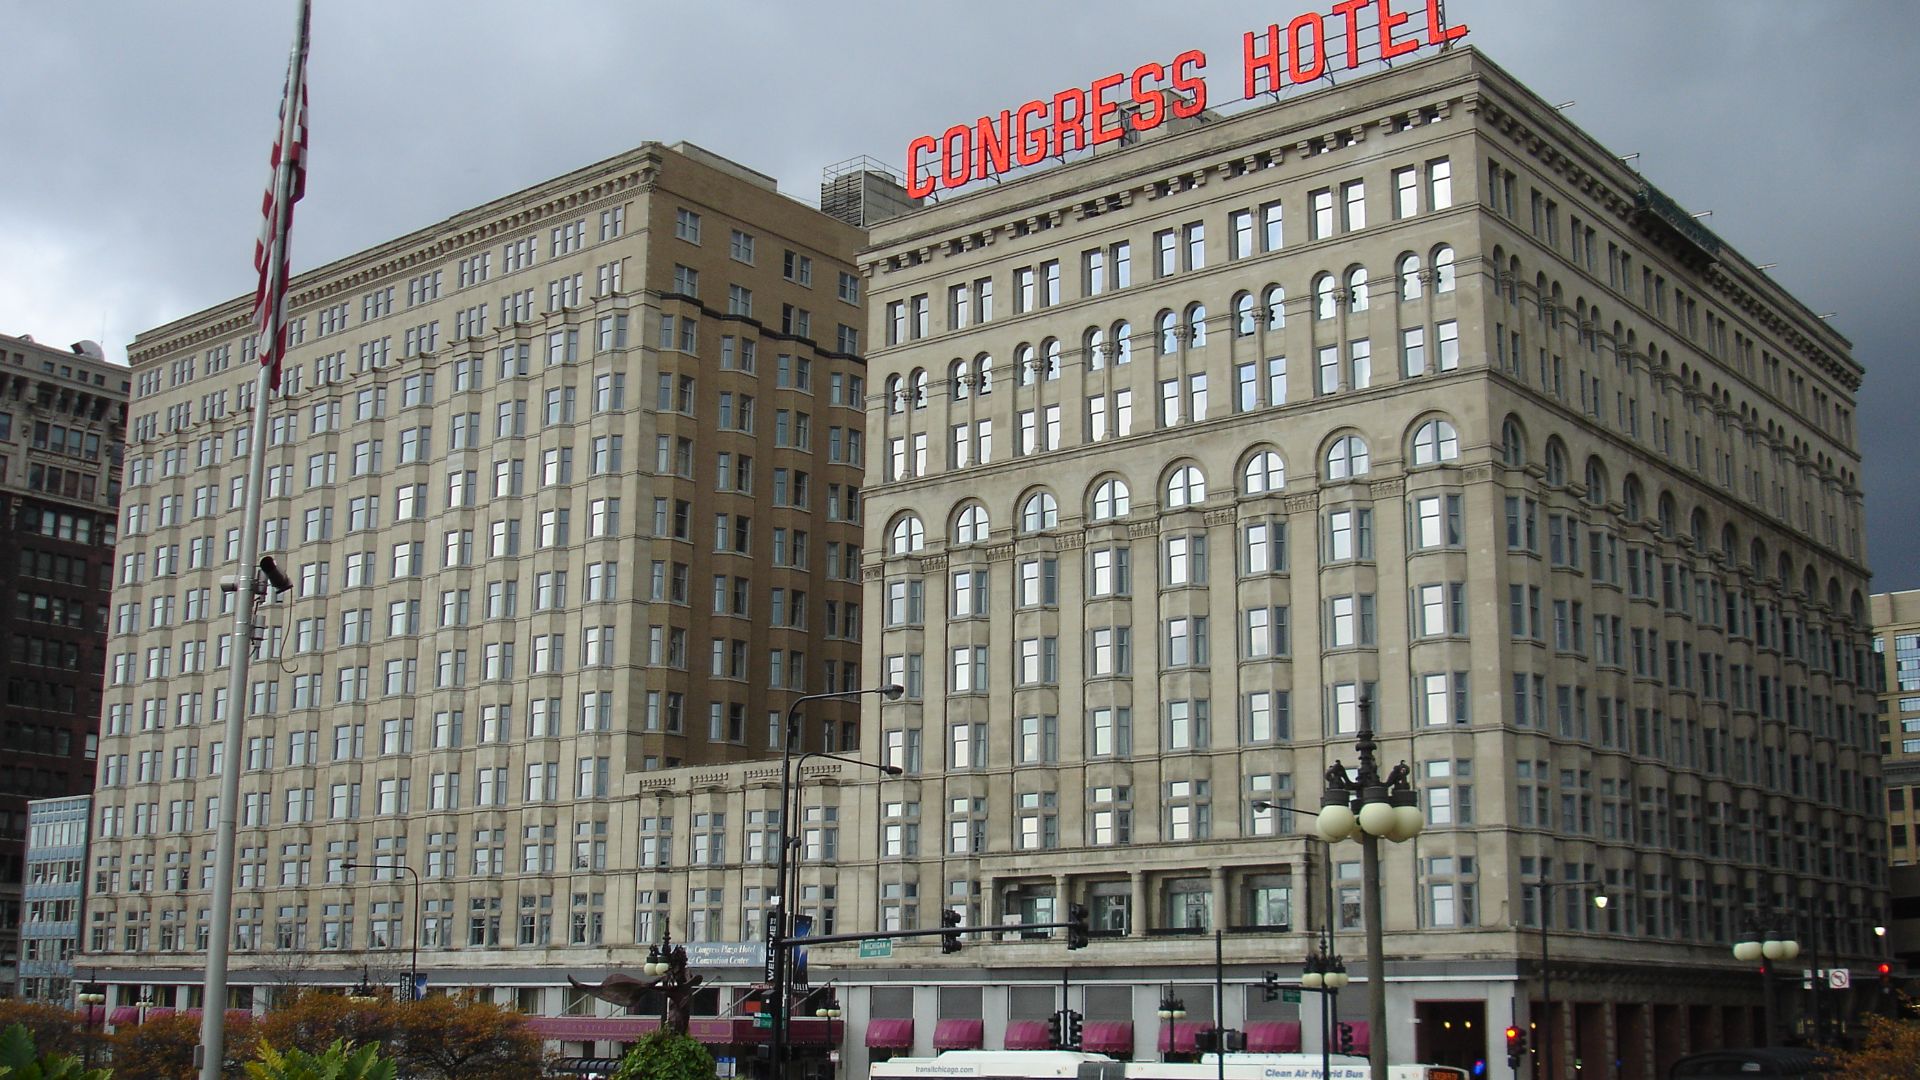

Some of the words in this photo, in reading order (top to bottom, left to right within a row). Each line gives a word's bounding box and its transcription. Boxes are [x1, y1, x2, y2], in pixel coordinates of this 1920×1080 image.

[907, 50, 1206, 198] CONGRESS
[1243, 0, 1467, 99] HOTEL
[695, 946, 720, 956] Congress
[721, 945, 738, 954] Plaza
[739, 944, 756, 953] Hotel
[729, 956, 750, 964] Center
[915, 1066, 974, 1074] transitchicago.com
[1265, 1069, 1292, 1077] Clean
[1294, 1069, 1309, 1078] Air
[1311, 1069, 1343, 1079] Hyrid
[1345, 1069, 1364, 1078] Bus
